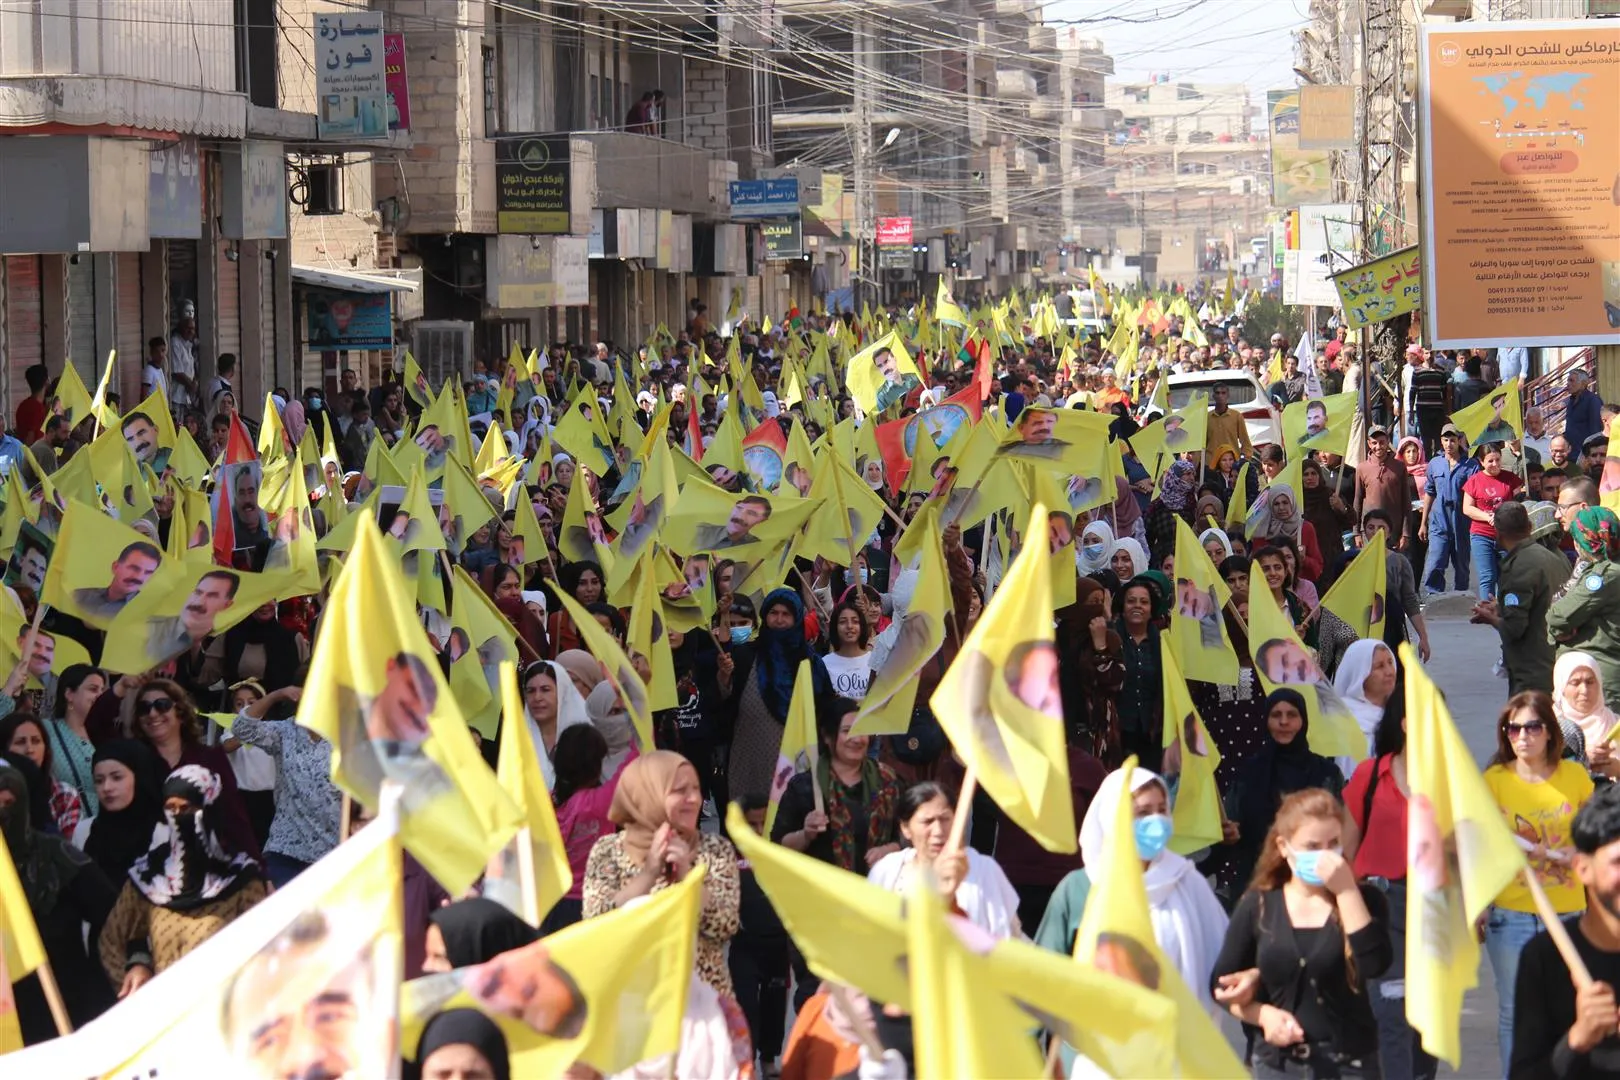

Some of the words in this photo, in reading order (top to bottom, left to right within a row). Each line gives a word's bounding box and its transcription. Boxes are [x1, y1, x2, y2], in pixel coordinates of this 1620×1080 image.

[1466, 44, 1511, 59] الدولي
[1516, 41, 1561, 57] للشحن
[326, 44, 372, 70] فون
[1570, 257, 1595, 265] للشحن
[1540, 271, 1568, 281] التواصل
